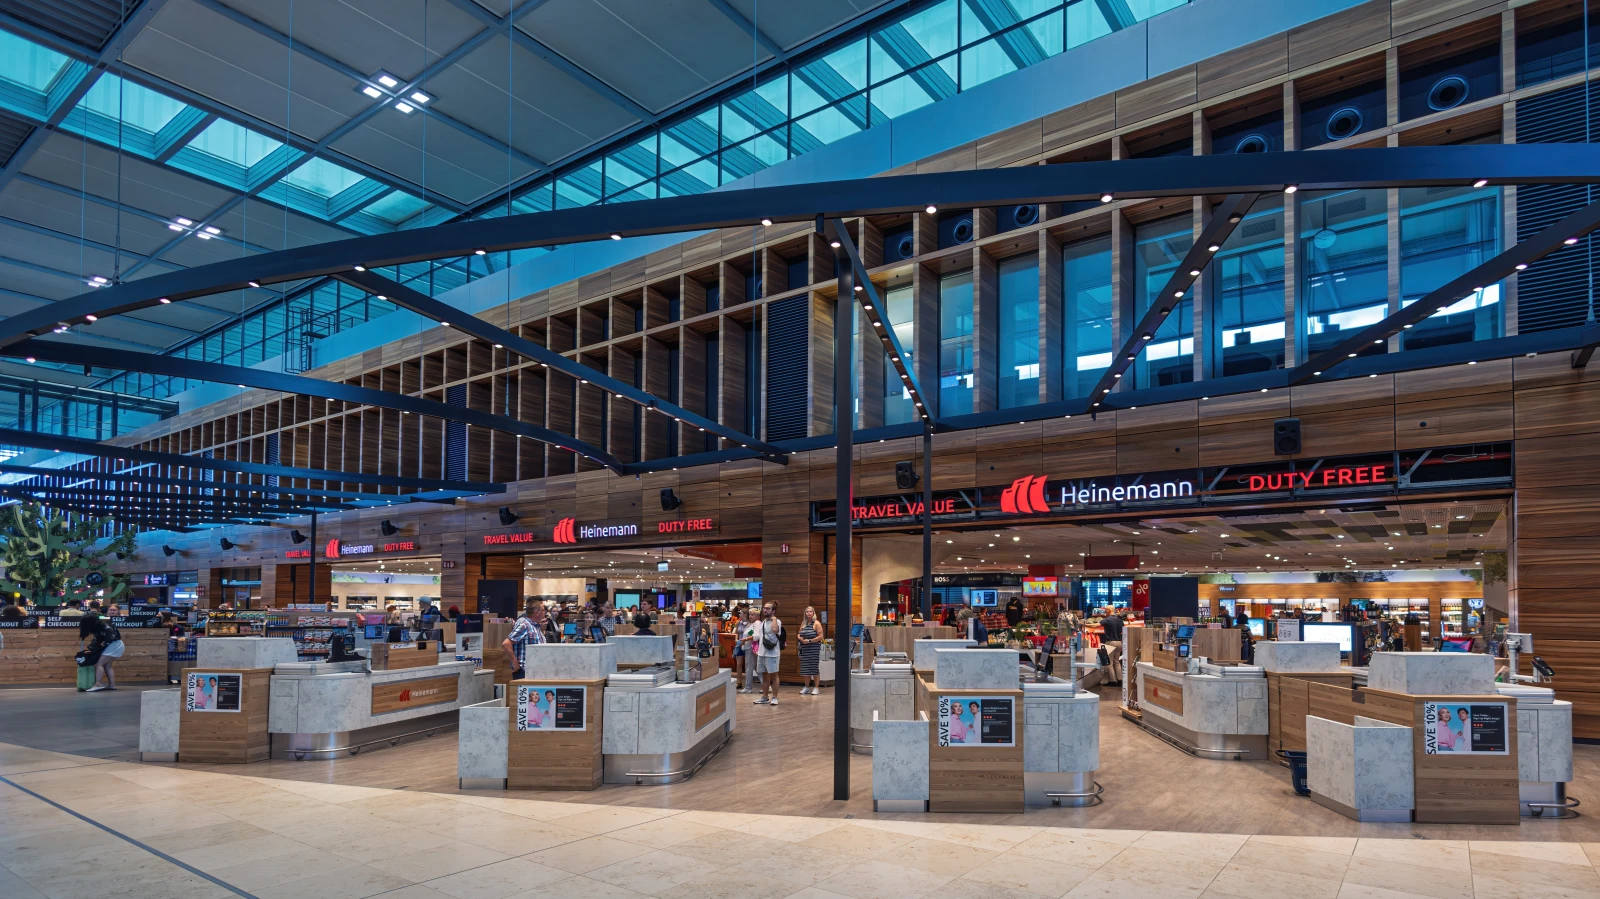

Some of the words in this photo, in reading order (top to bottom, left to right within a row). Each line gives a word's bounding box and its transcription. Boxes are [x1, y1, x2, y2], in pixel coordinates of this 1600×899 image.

[1249, 471, 1315, 491] DUTY
[1323, 465, 1386, 486] FREE
[1061, 480, 1193, 505] Heinemann
[851, 504, 903, 519] TRAVEL
[580, 523, 637, 539] Heinemann
[658, 521, 686, 533] DUTY
[687, 518, 712, 531] FREE
[384, 543, 399, 552] DUTY
[400, 541, 414, 550] FREE
[483, 534, 509, 545] TRAVEL
[509, 532, 533, 543] VALUE
[341, 544, 374, 555] Heinemann
[411, 688, 439, 698] Heinemann
[187, 691, 195, 712] SAVE
[519, 708, 527, 731] SAVE
[940, 721, 949, 747] SAVE
[1426, 727, 1437, 755] SAVE
